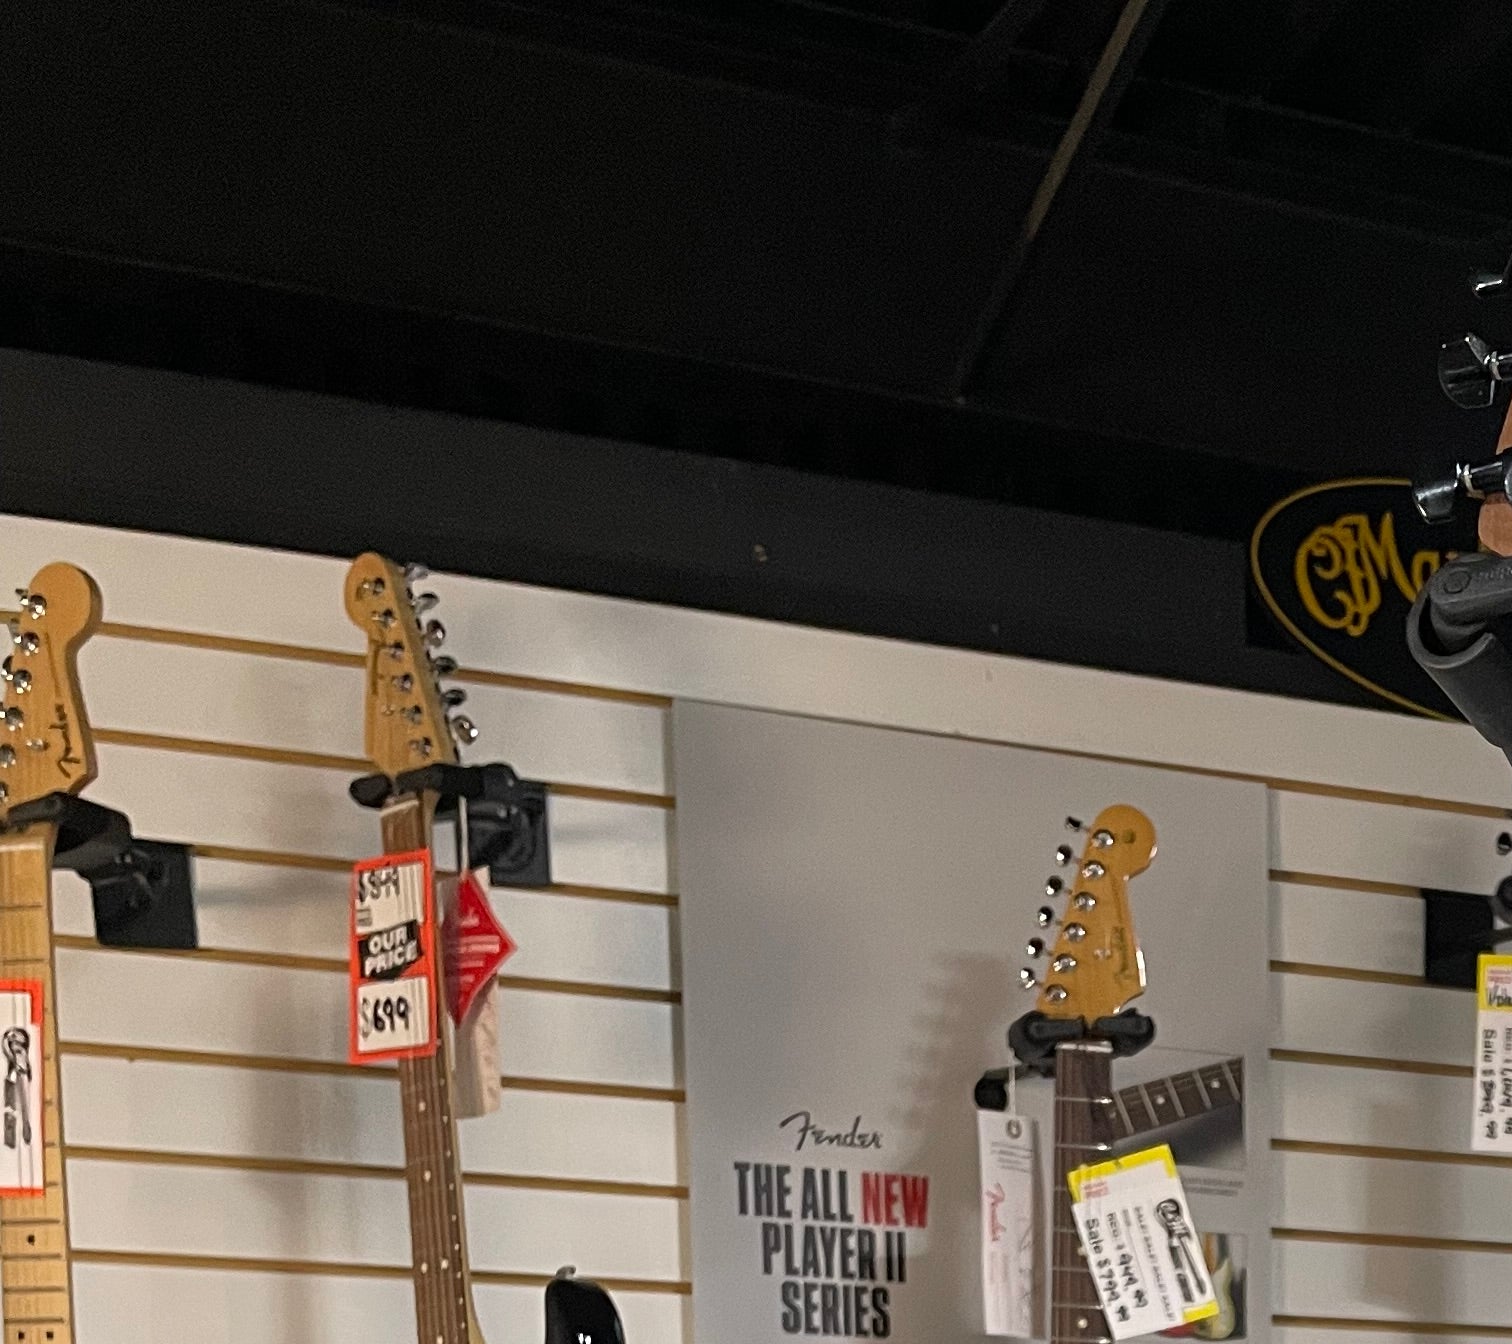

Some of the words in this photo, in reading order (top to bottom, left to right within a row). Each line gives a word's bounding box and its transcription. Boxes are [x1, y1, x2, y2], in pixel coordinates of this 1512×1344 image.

[364, 941, 418, 979] PRICE
[369, 926, 407, 954] OUR
[360, 997, 410, 1038] $699
[779, 1110, 882, 1151] Fender
[734, 1161, 793, 1218] THE
[801, 1167, 854, 1222] ALL
[861, 1171, 929, 1229] NEW
[762, 1222, 876, 1281] PLAYER
[885, 1231, 906, 1282] II
[1086, 1218, 1103, 1254] Sale
[781, 1281, 891, 1339] SERIES
